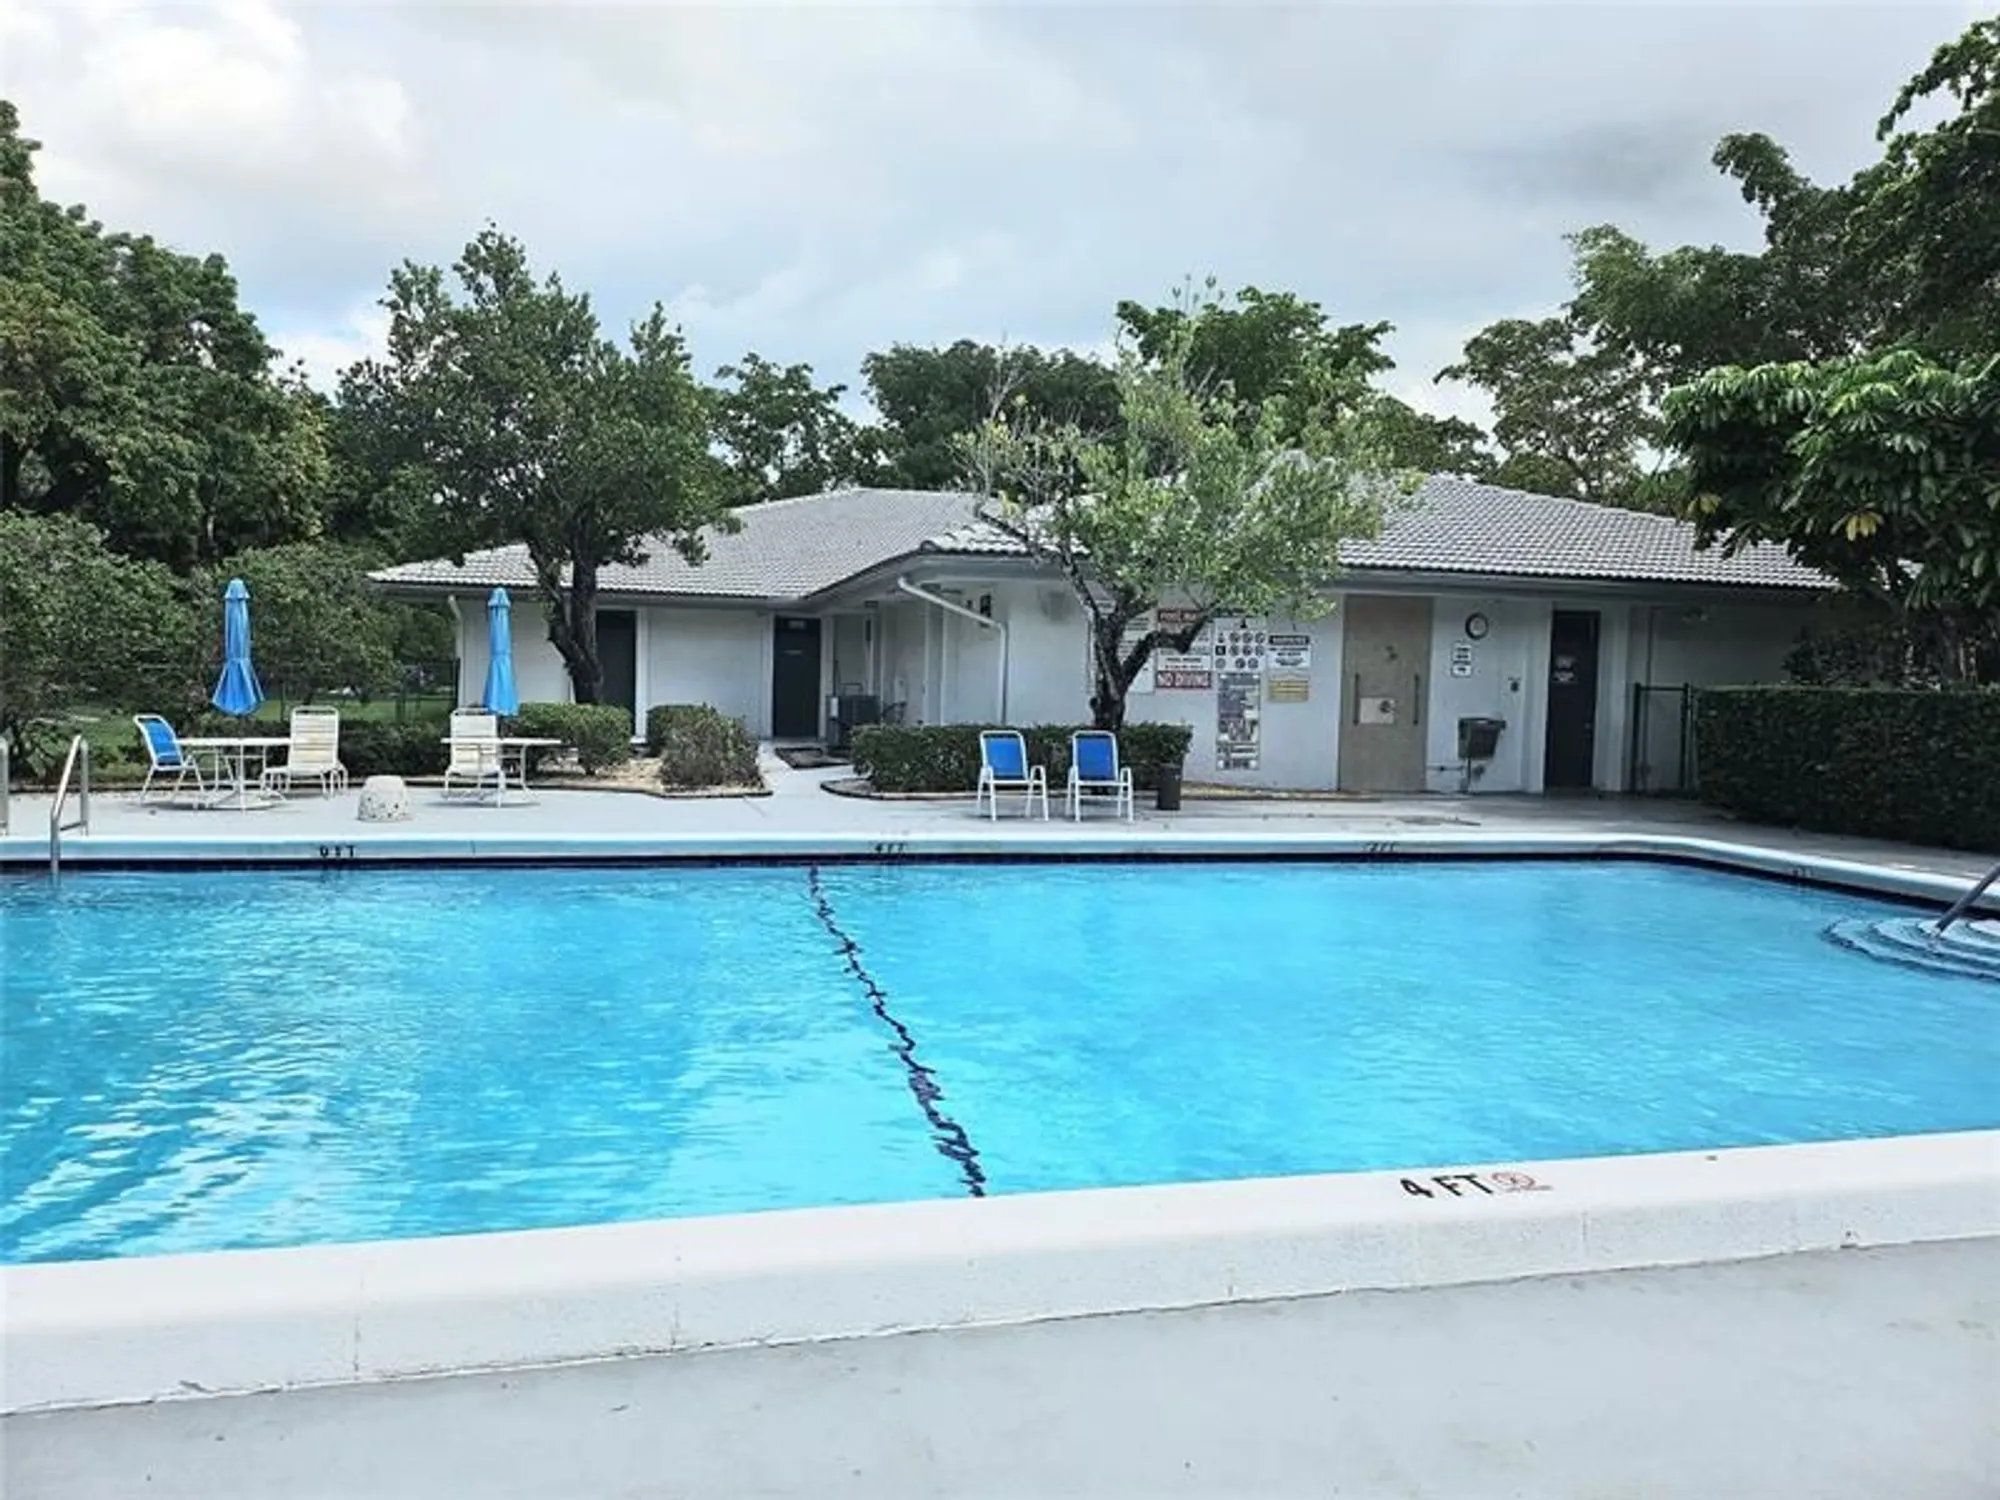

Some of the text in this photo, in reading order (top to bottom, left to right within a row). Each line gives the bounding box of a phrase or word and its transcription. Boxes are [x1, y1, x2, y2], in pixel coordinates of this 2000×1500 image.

[1157, 672, 1210, 687] NO DIVING
[1400, 1173, 1494, 1198] 4 FT
